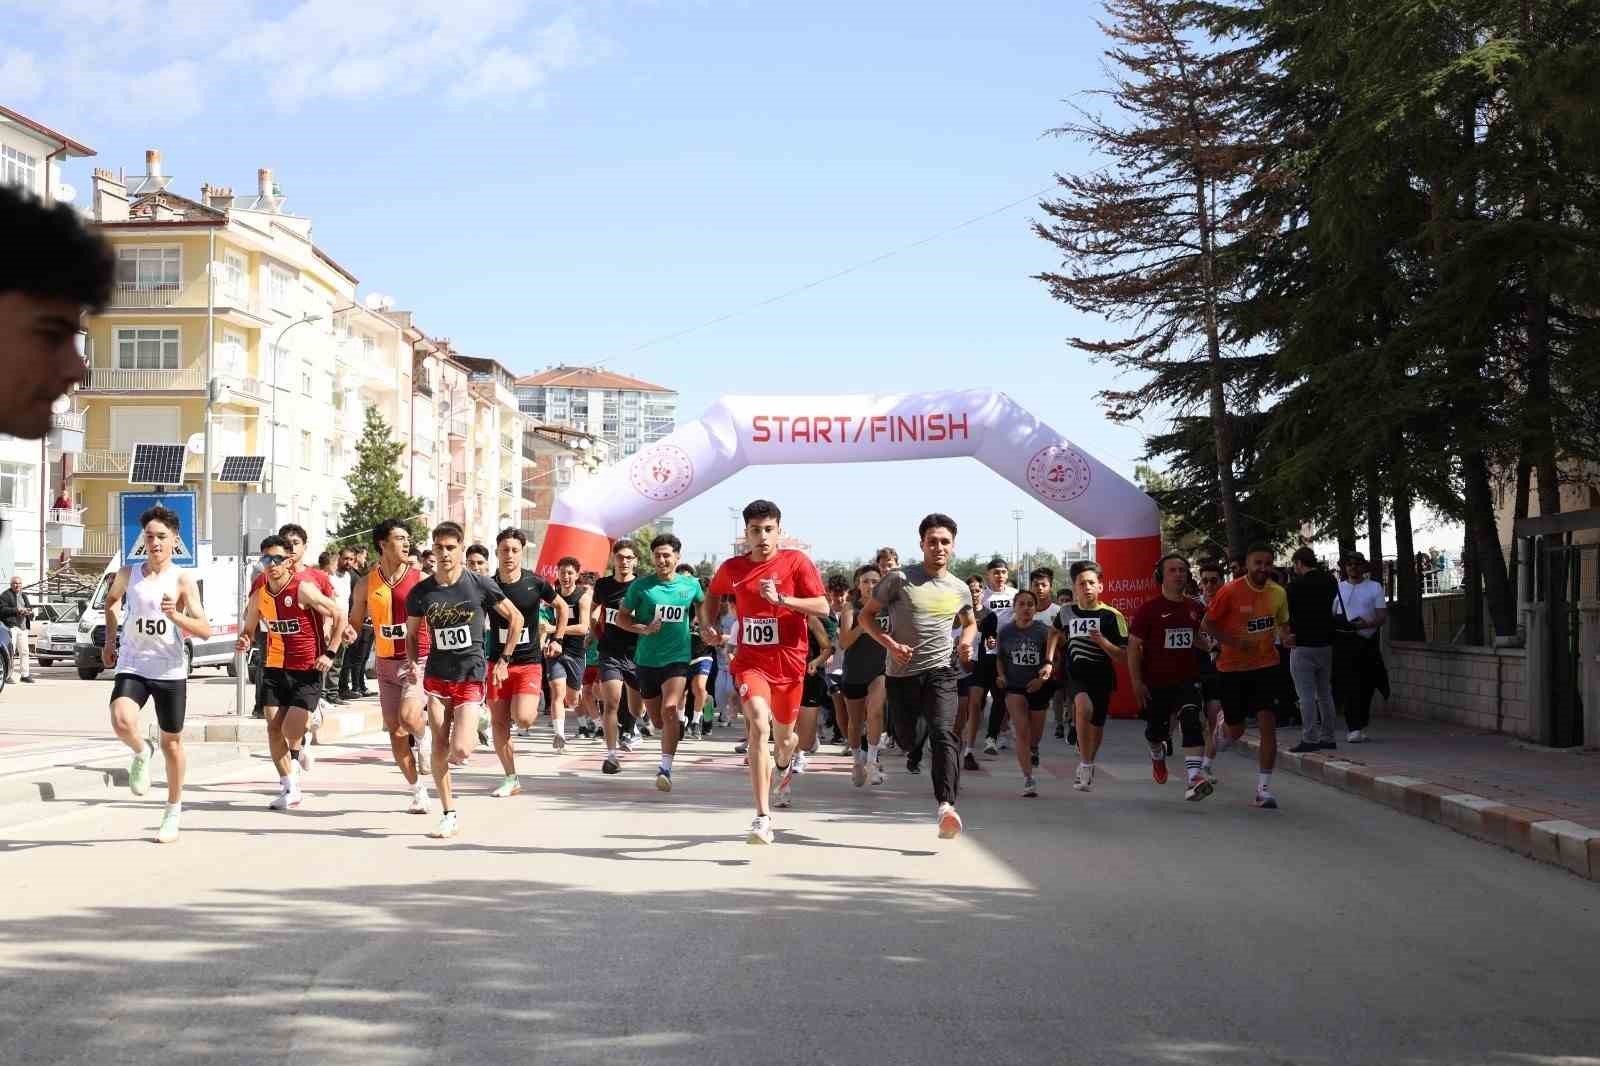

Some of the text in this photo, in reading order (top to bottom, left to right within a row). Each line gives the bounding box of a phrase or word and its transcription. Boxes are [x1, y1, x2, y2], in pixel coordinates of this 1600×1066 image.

[752, 413, 968, 443] START/FINISH
[659, 606, 682, 620] 100
[136, 618, 167, 636] 150
[746, 625, 773, 643] 109
[440, 628, 467, 646] 130
[1168, 632, 1191, 647] 133
[1015, 653, 1036, 665] 145
